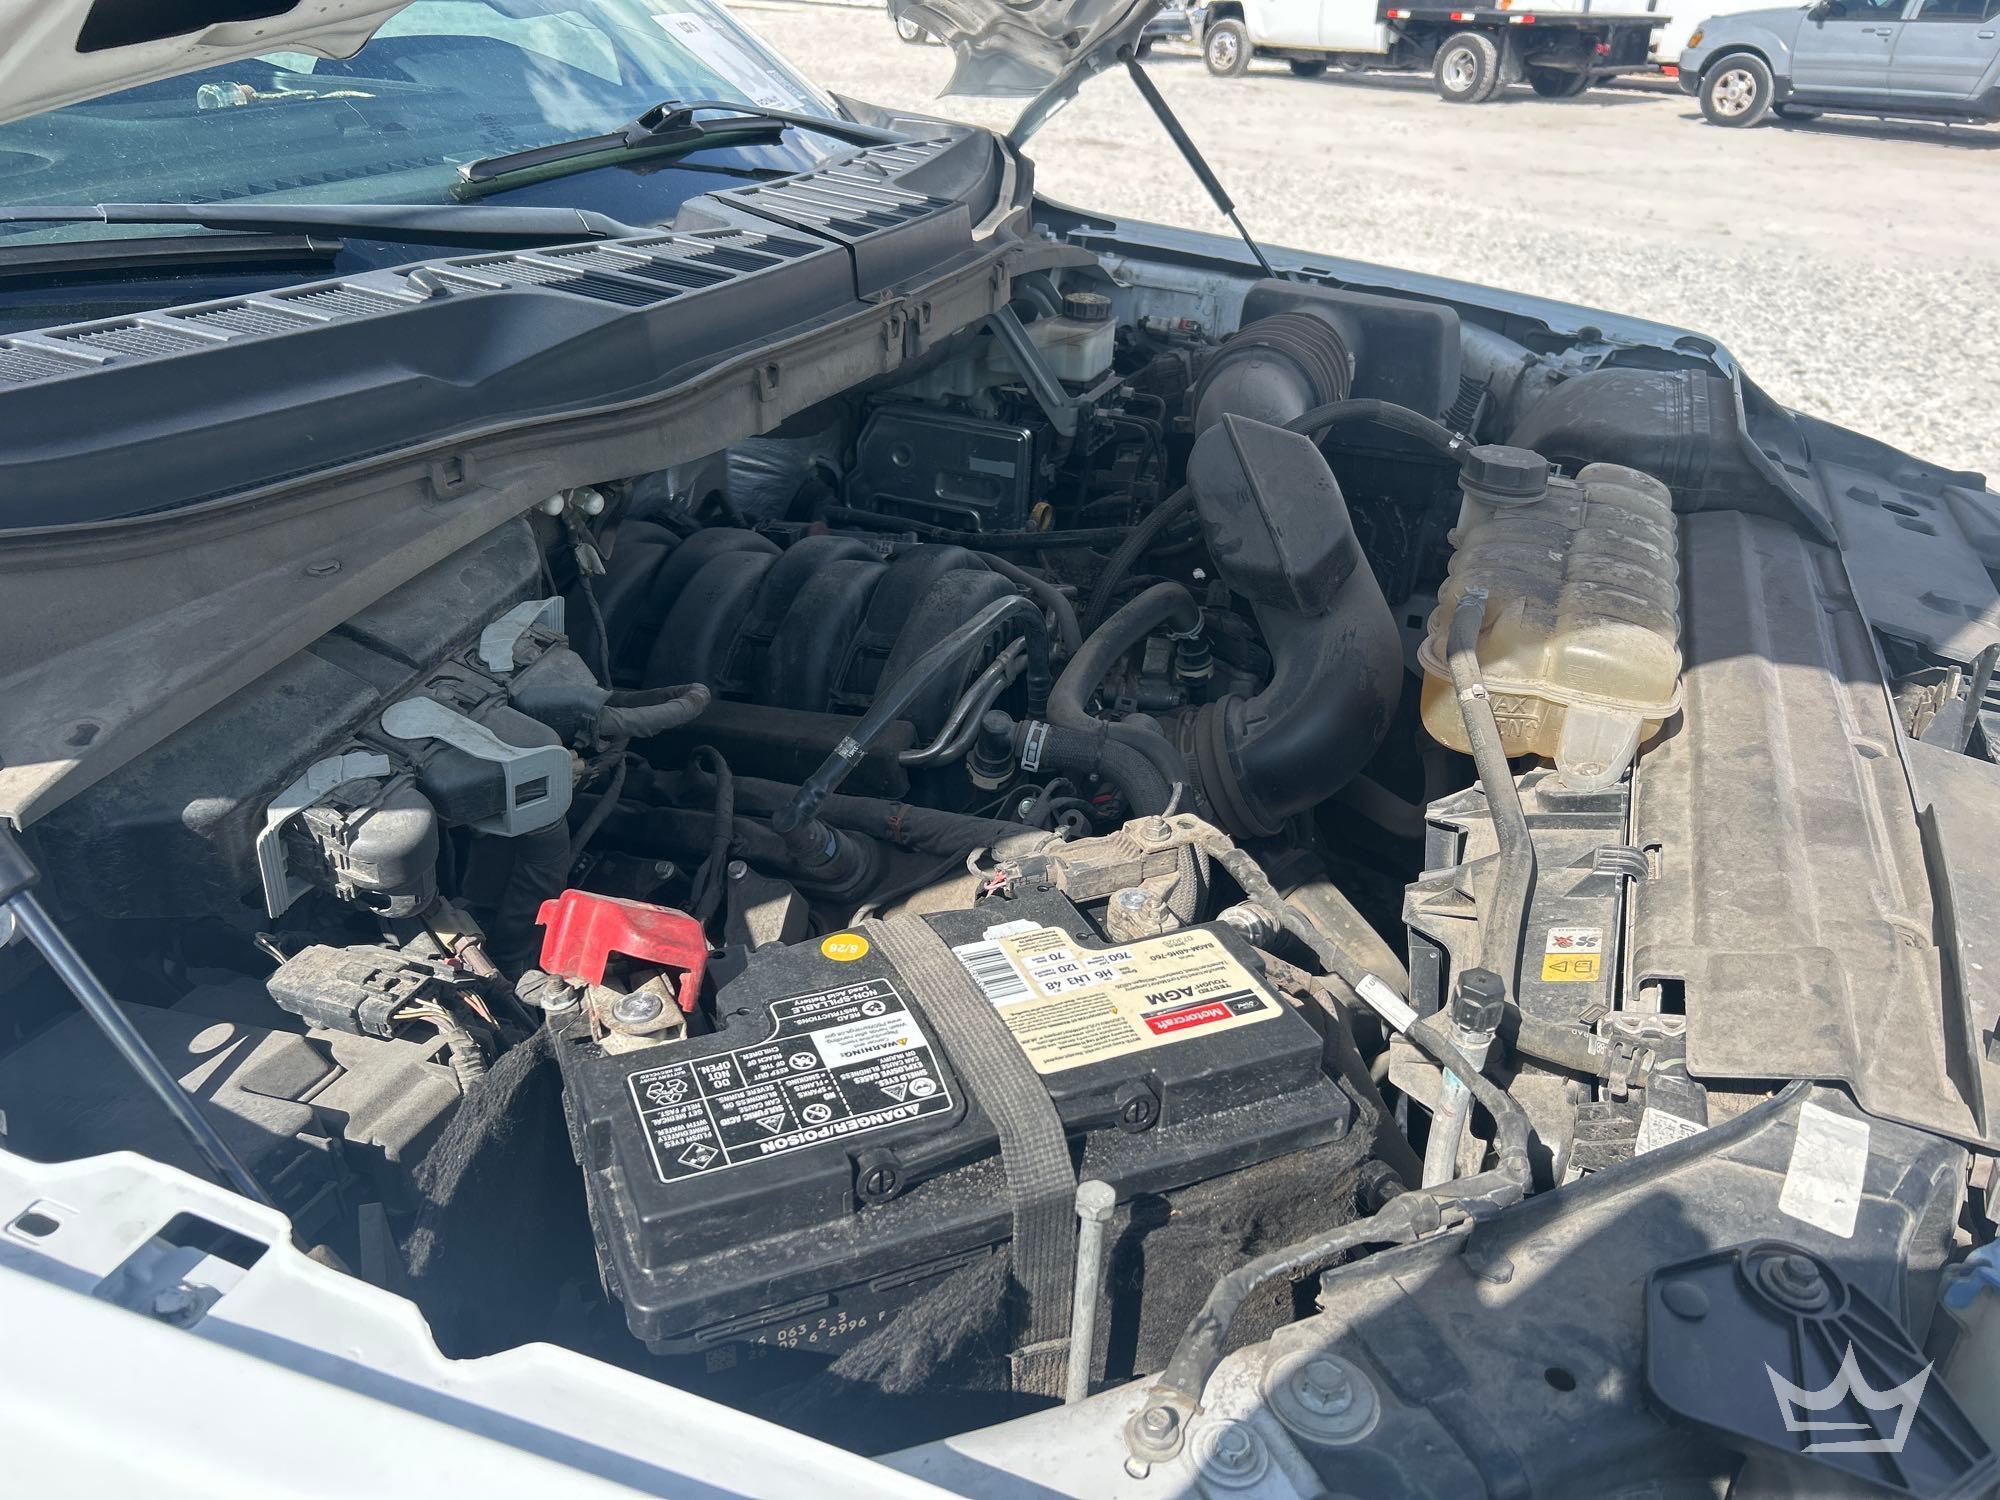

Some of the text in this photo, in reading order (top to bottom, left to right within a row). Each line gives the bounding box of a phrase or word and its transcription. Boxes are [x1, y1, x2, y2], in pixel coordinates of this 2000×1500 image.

[1047, 951, 1065, 960] 70
[1107, 951, 1132, 961] 760
[1148, 942, 1214, 961] BAGM-48H6-760
[1056, 963, 1078, 973] 120
[1044, 968, 1113, 990] H6 LN3 48
[1197, 982, 1231, 994] TESTED
[790, 988, 877, 1013] NON-SPILLABLE
[793, 985, 869, 1006] Lead Acid Battery
[1144, 985, 1196, 1005] AGM
[1236, 1000, 1255, 1010] Ford
[793, 1006, 858, 1025] INSTRUCTIONS.
[836, 1011, 860, 1021] READ
[1154, 1006, 1224, 1030] Motorcraft
[738, 1045, 779, 1060] CHILDREN.
[756, 1052, 782, 1063] REACH
[839, 1039, 897, 1058] WARNING:
[877, 1052, 904, 1063] INJURY.
[696, 1060, 730, 1075] OPEN.
[706, 1069, 730, 1081] NOT
[752, 1066, 789, 1080] KEEP OUT
[758, 1062, 774, 1070] THE
[839, 1055, 919, 1080] CAN CAUSE BLINDNESS
[852, 1061, 923, 1084] EXPLOSIVE GASES
[712, 1078, 730, 1088] DO
[784, 1072, 820, 1086] SMOKING
[793, 1079, 824, 1091] FLAMES
[873, 1068, 928, 1087] SHIELD EYES.
[715, 1084, 774, 1103] SEVERE BURNS.
[721, 1090, 777, 1109] BLINDNESS OR
[796, 1085, 827, 1098] SPARKS
[822, 1091, 836, 1100] NO
[656, 1102, 700, 1117] HELP FAST.
[737, 1097, 780, 1112] CAN CAUSE
[650, 1108, 703, 1126] GET MEDICAL
[719, 1104, 784, 1126] SULFURIC ACID
[654, 1118, 707, 1136] WITH WATER.
[656, 1124, 710, 1142] IMMEDIATELY
[758, 1106, 906, 1152] DANGER/POISON
[663, 1130, 712, 1148] FLUSH EYES
[778, 1324, 806, 1340] 063
[818, 1318, 826, 1329] 2
[838, 1312, 846, 1323] 3
[809, 1332, 818, 1342] 6
[829, 1317, 866, 1336] 2996
